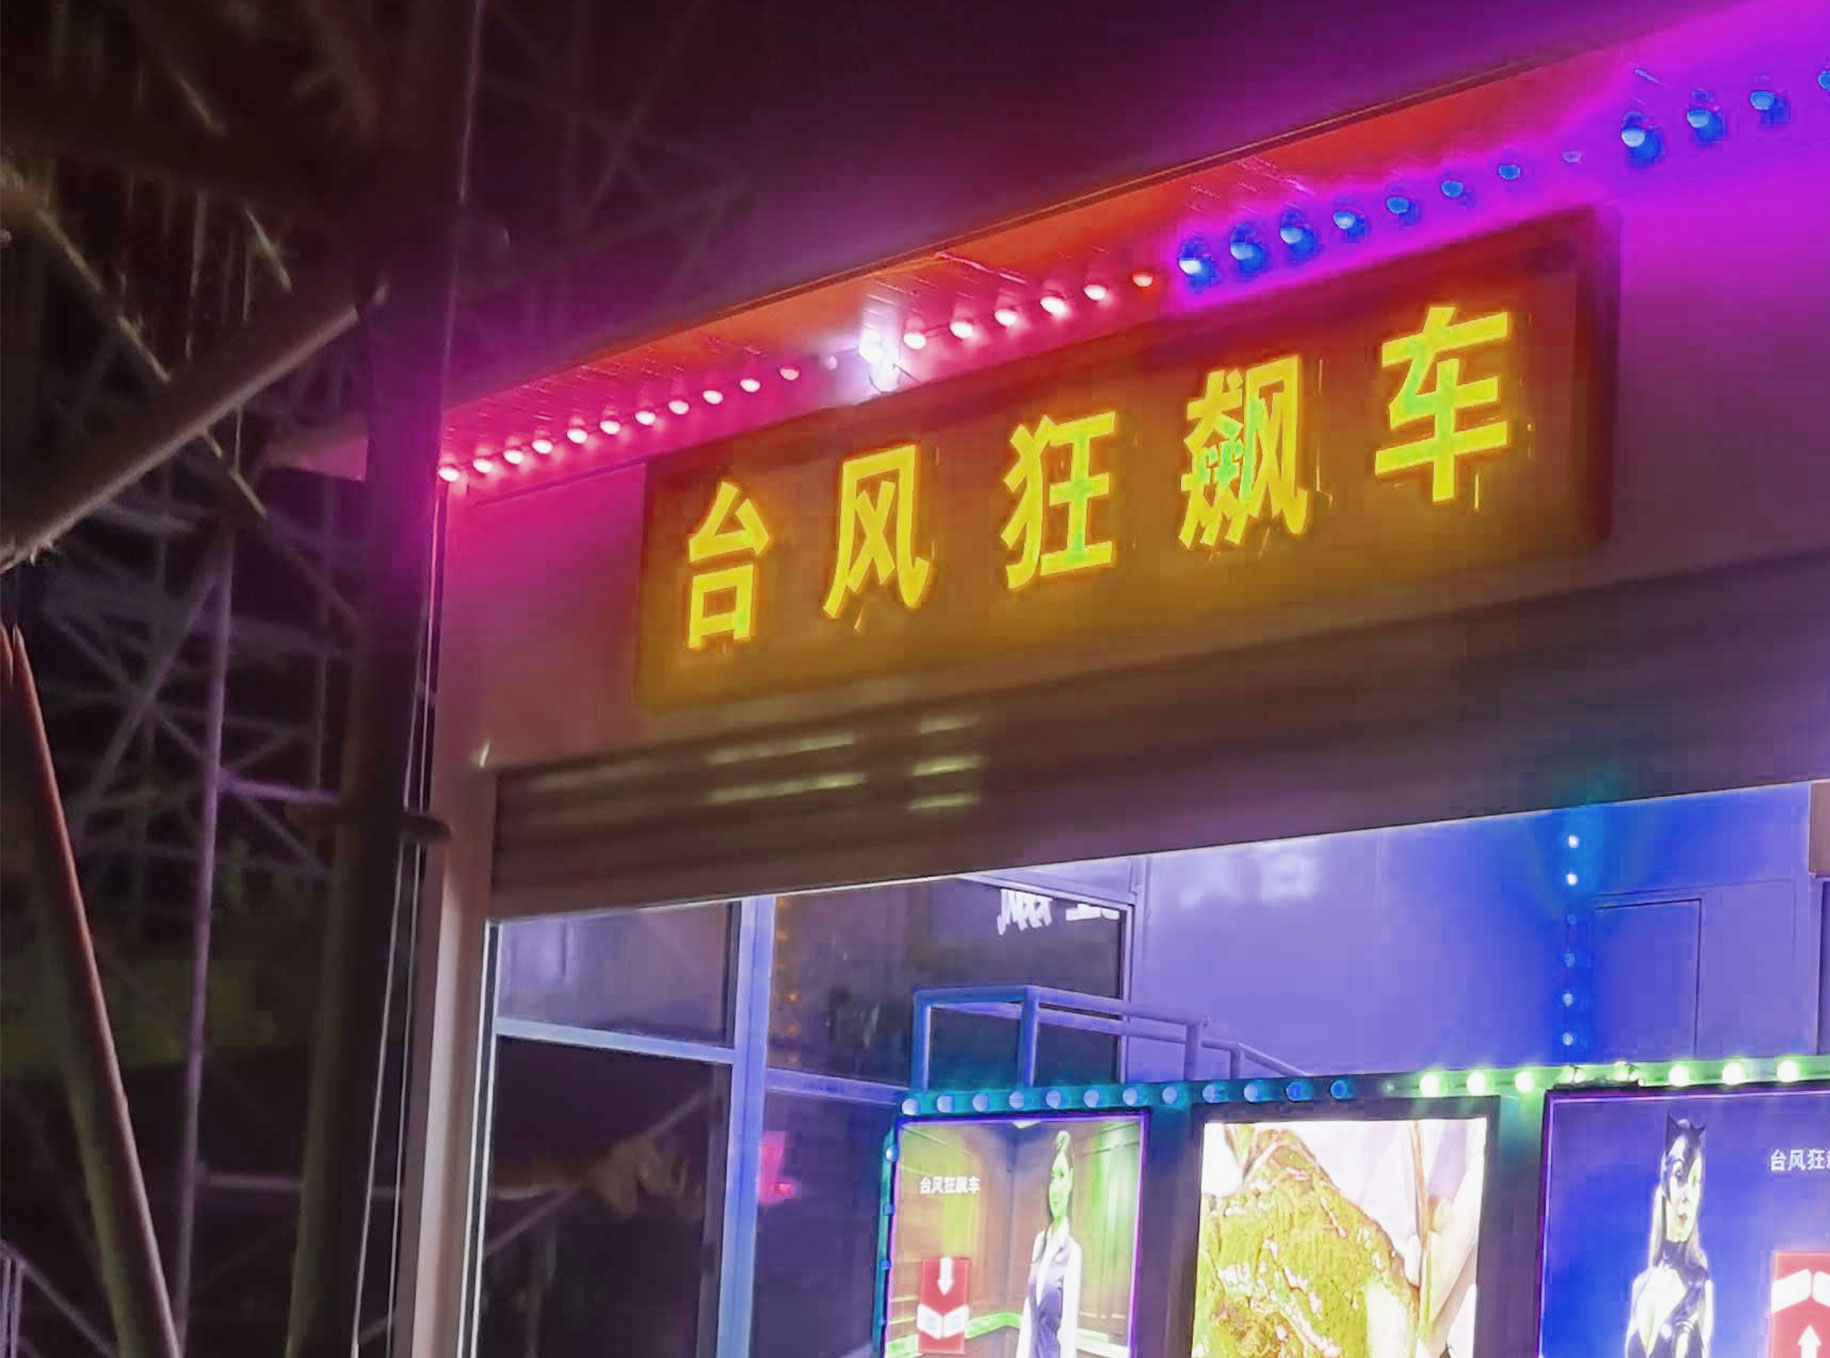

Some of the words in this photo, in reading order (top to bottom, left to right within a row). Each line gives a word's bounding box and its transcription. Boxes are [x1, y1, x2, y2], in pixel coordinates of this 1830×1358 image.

[687, 306, 1510, 651] 台风狂飙车
